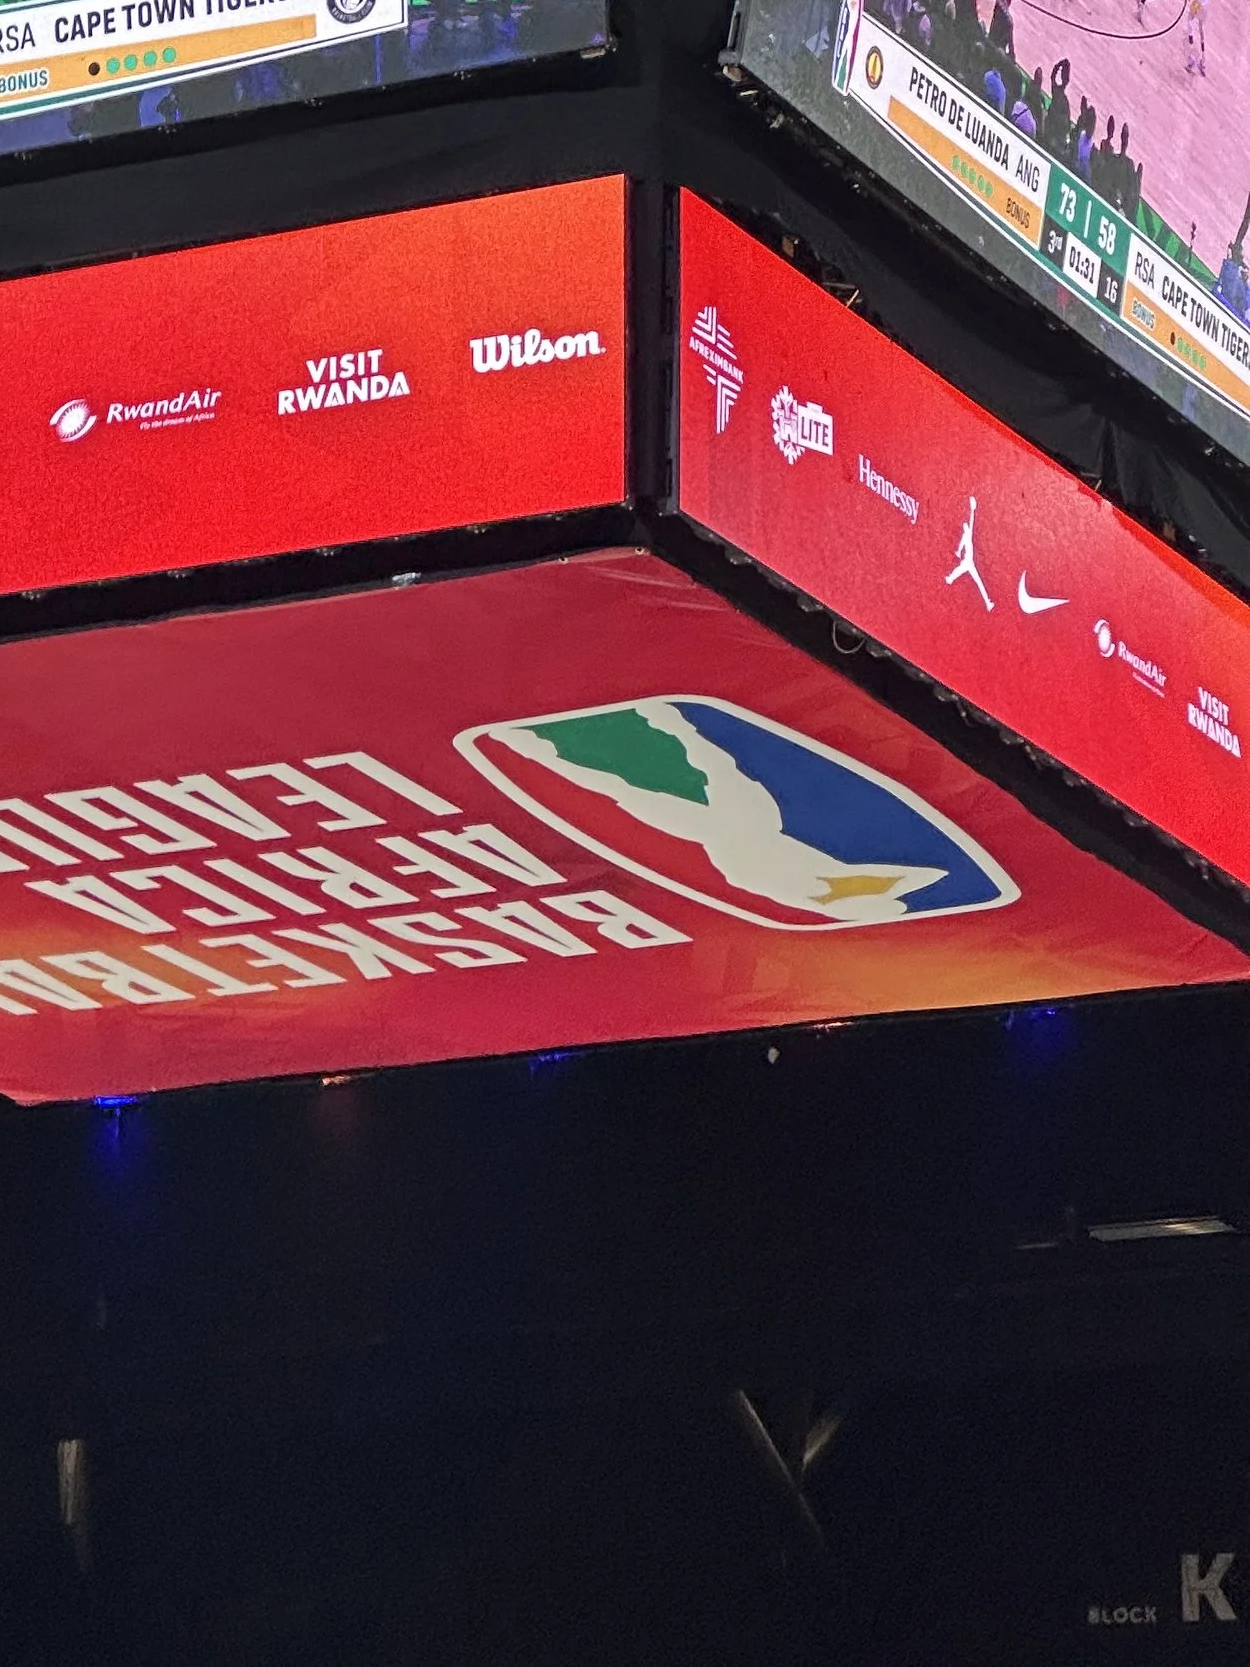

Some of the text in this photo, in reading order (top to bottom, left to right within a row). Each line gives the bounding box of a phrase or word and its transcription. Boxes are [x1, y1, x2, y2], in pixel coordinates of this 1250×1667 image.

[54, 8, 115, 44] CAPE
[909, 66, 1040, 194] PETRO DE LUANDA ANG
[1005, 197, 1031, 229] BONUS
[1059, 182, 1116, 255] 73 58
[1068, 244, 1096, 285] 01:31
[1103, 277, 1119, 304] 16
[1131, 298, 1156, 331] BONUS
[1134, 250, 1250, 371] RSA CAPE TOWN TIGER
[306, 348, 383, 382] VISIT
[106, 388, 222, 424] RwandAir
[277, 371, 411, 416] RWANDA
[801, 415, 829, 448] LITE
[859, 453, 920, 525] Hennessy
[1118, 641, 1167, 687] RwandAir
[1197, 686, 1229, 726] VISIT
[1187, 702, 1242, 758] RWANDA
[25, 822, 567, 933] AFRICA
[1181, 1551, 1238, 1622] K
